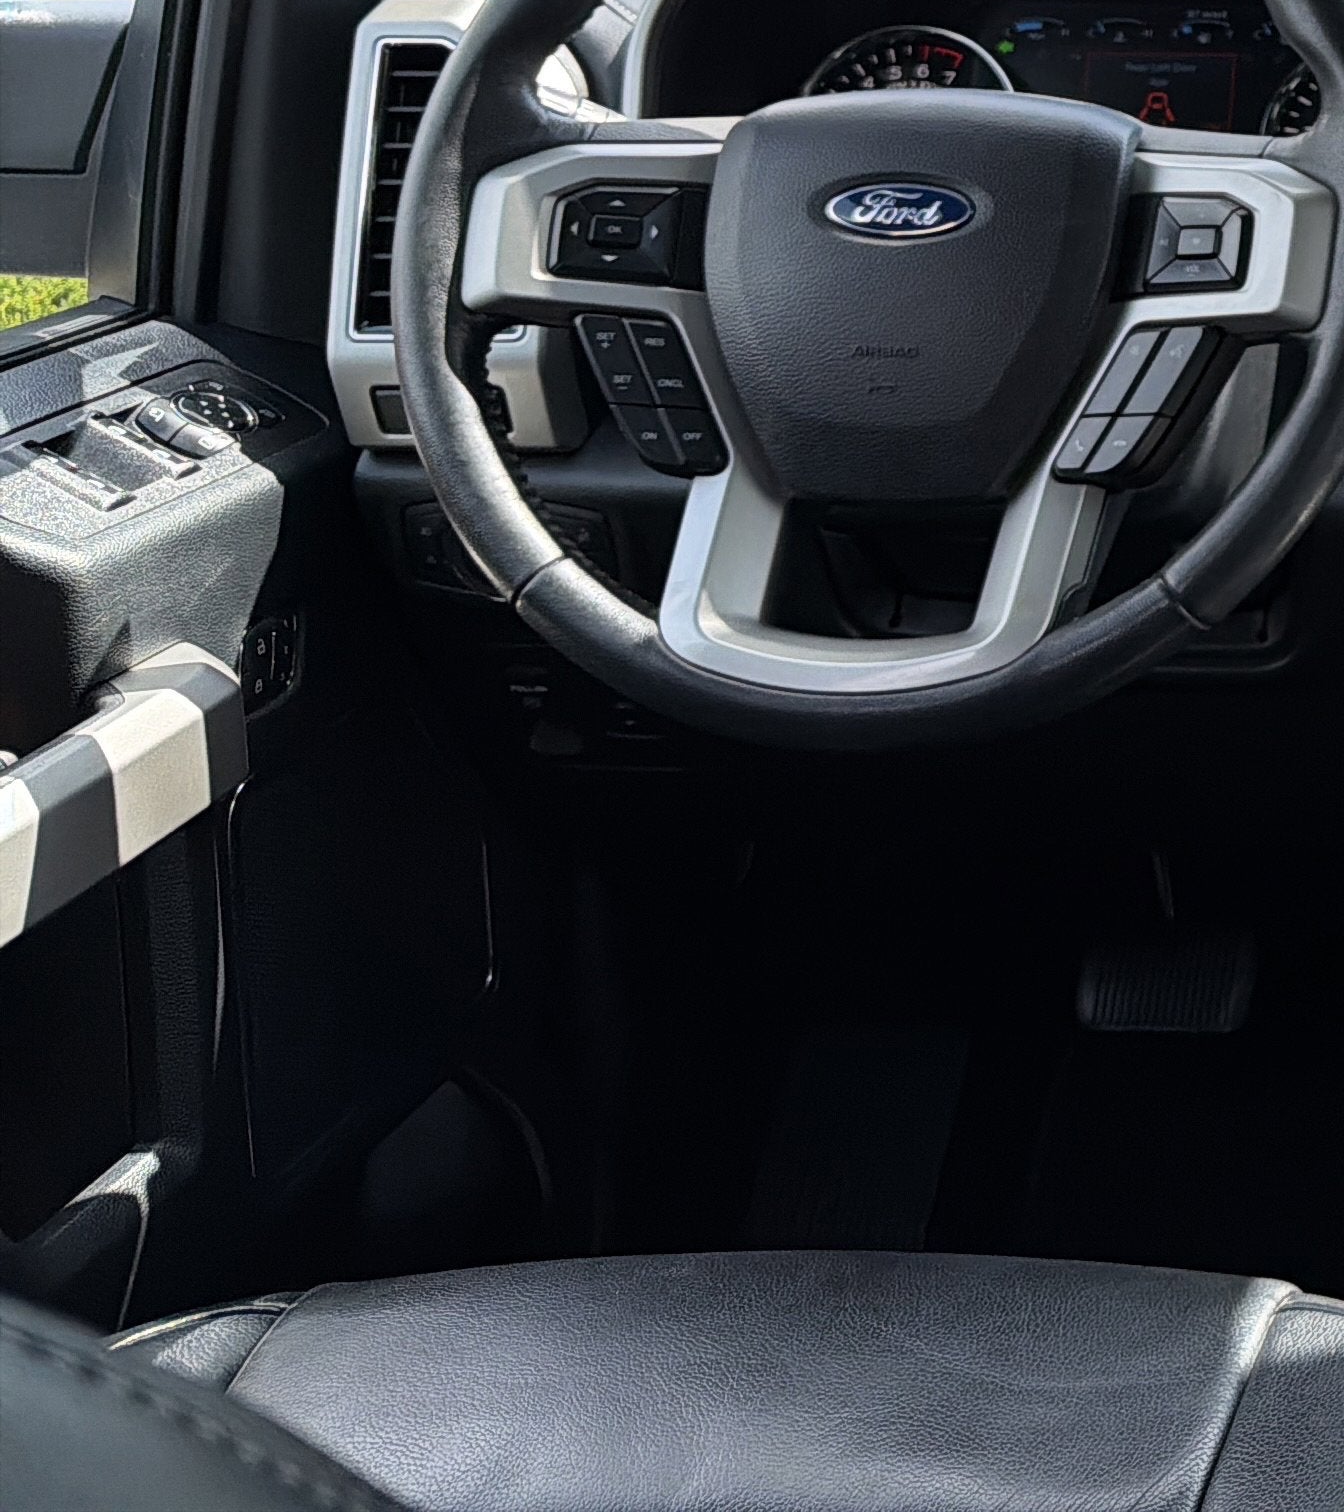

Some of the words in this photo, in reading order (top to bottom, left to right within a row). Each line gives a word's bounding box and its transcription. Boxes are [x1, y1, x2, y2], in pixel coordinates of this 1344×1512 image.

[915, 63, 930, 79] 6
[942, 70, 957, 86] 7
[853, 189, 943, 226] Ford
[606, 224, 623, 235] OK
[596, 331, 616, 341] SET
[643, 337, 666, 347] RES
[612, 374, 632, 384] SET
[657, 378, 685, 388] CNCL
[641, 431, 658, 441] ON
[682, 431, 703, 441] OFF
